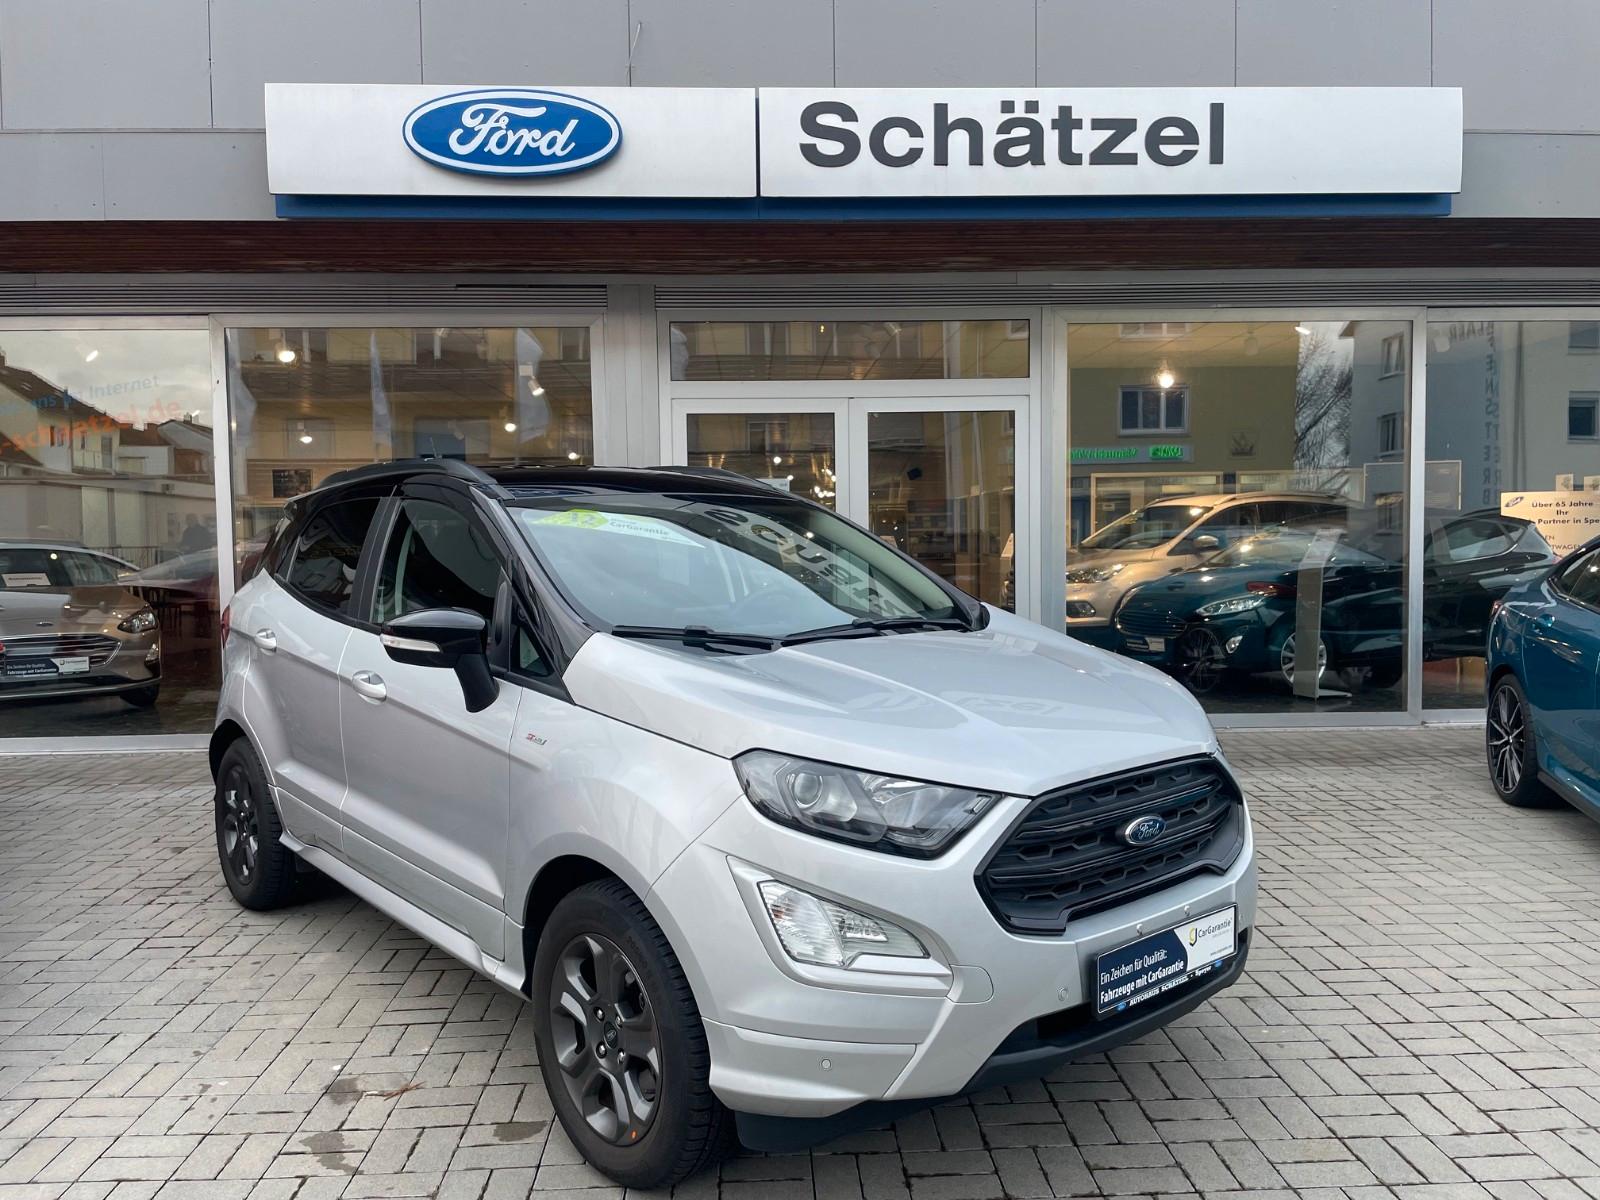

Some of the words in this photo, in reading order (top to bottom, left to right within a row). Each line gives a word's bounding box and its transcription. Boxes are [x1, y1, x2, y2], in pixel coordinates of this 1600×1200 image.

[448, 103, 578, 157] Ford
[799, 100, 1225, 168] Schätzel
[89, 375, 160, 398] Internet
[1137, 820, 1160, 840] Ford
[1197, 918, 1232, 938] CarGarantie
[1100, 972, 1110, 985] Ein
[1110, 963, 1134, 981] Zeichen
[1134, 958, 1143, 971] für
[1100, 981, 1135, 1004] Fahrzeuge
[1135, 974, 1148, 989] mit
[1147, 959, 1184, 983] CarGarantie
